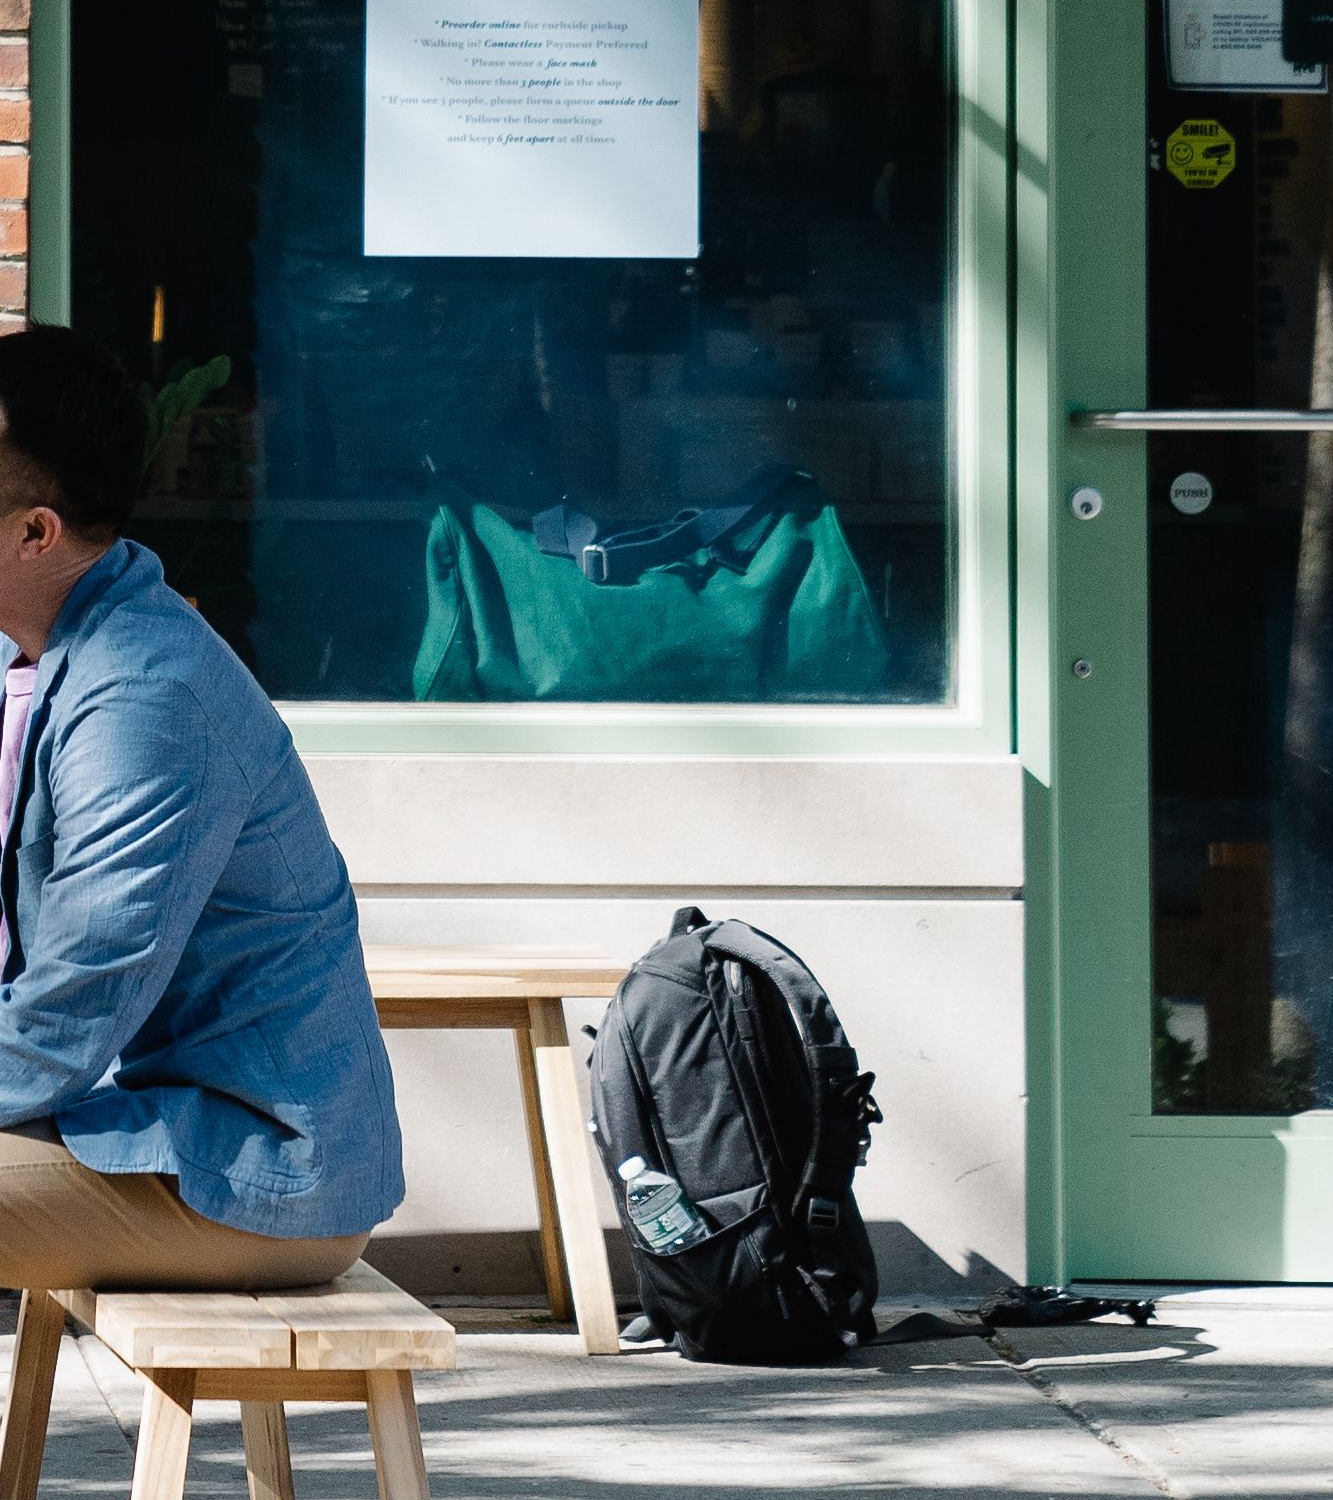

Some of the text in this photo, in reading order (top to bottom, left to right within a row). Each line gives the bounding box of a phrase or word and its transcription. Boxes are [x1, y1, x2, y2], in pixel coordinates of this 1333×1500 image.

[441, 20, 628, 32] Preorder online for curbside pickup
[421, 39, 648, 50] Walking in? Contactless Payment Preferred
[472, 59, 506, 67] Please
[545, 59, 568, 69] face
[569, 59, 597, 68] mask
[447, 78, 462, 86] No
[495, 78, 518, 86] than
[526, 79, 561, 89] people
[564, 79, 575, 87] in
[577, 79, 594, 87] the
[596, 79, 621, 89] shop
[389, 96, 399, 105] If
[399, 98, 419, 107] you
[449, 97, 487, 107] people,
[491, 97, 524, 107] please
[526, 97, 554, 105] form
[563, 100, 596, 108] queue
[598, 97, 636, 106] outside
[638, 97, 654, 106] the
[656, 97, 681, 106] door
[466, 115, 603, 126] Follow the floor markings
[1182, 124, 1219, 137] SMILE!
[447, 134, 467, 143] and
[470, 135, 494, 145] keep
[497, 135, 503, 143] 6
[503, 134, 524, 145] feet
[526, 136, 555, 146] apart
[570, 135, 583, 143] all
[586, 135, 615, 144] times
